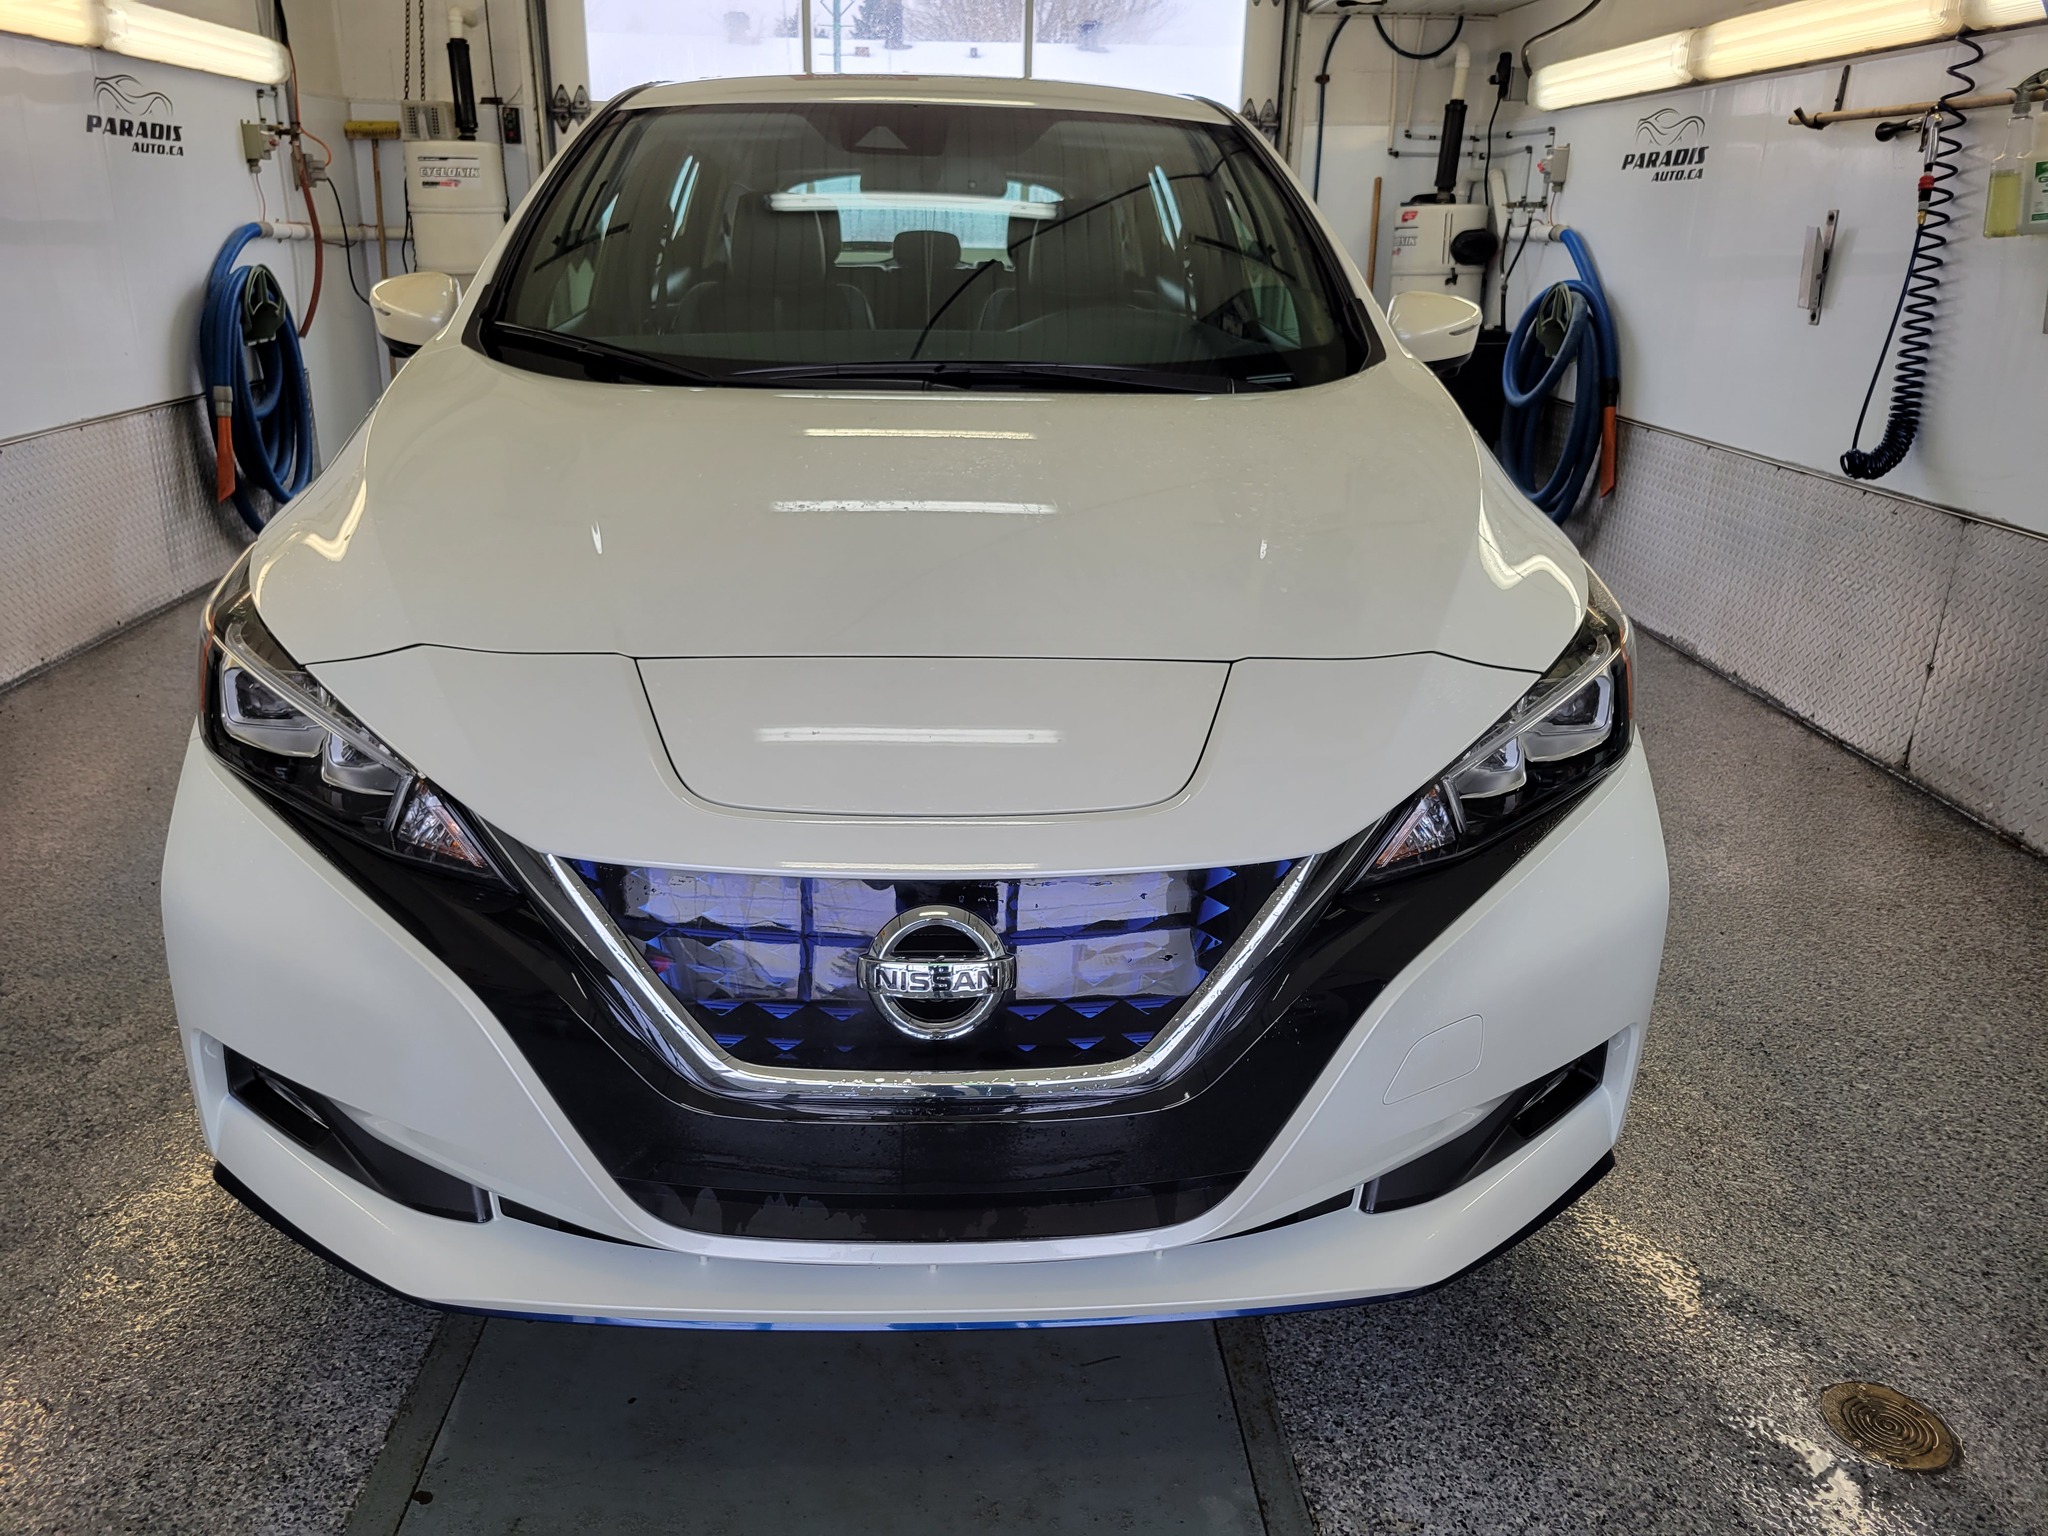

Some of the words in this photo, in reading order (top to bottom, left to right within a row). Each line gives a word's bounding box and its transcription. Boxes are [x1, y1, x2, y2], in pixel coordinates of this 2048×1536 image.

[86, 114, 182, 142] PARADIS
[132, 142, 184, 157] AUTO.CA
[1621, 146, 1709, 170] PARADIS
[420, 167, 480, 178] CYCLONIK
[1651, 168, 1704, 182] AUTO.CA
[875, 967, 1000, 992] NISSAN
